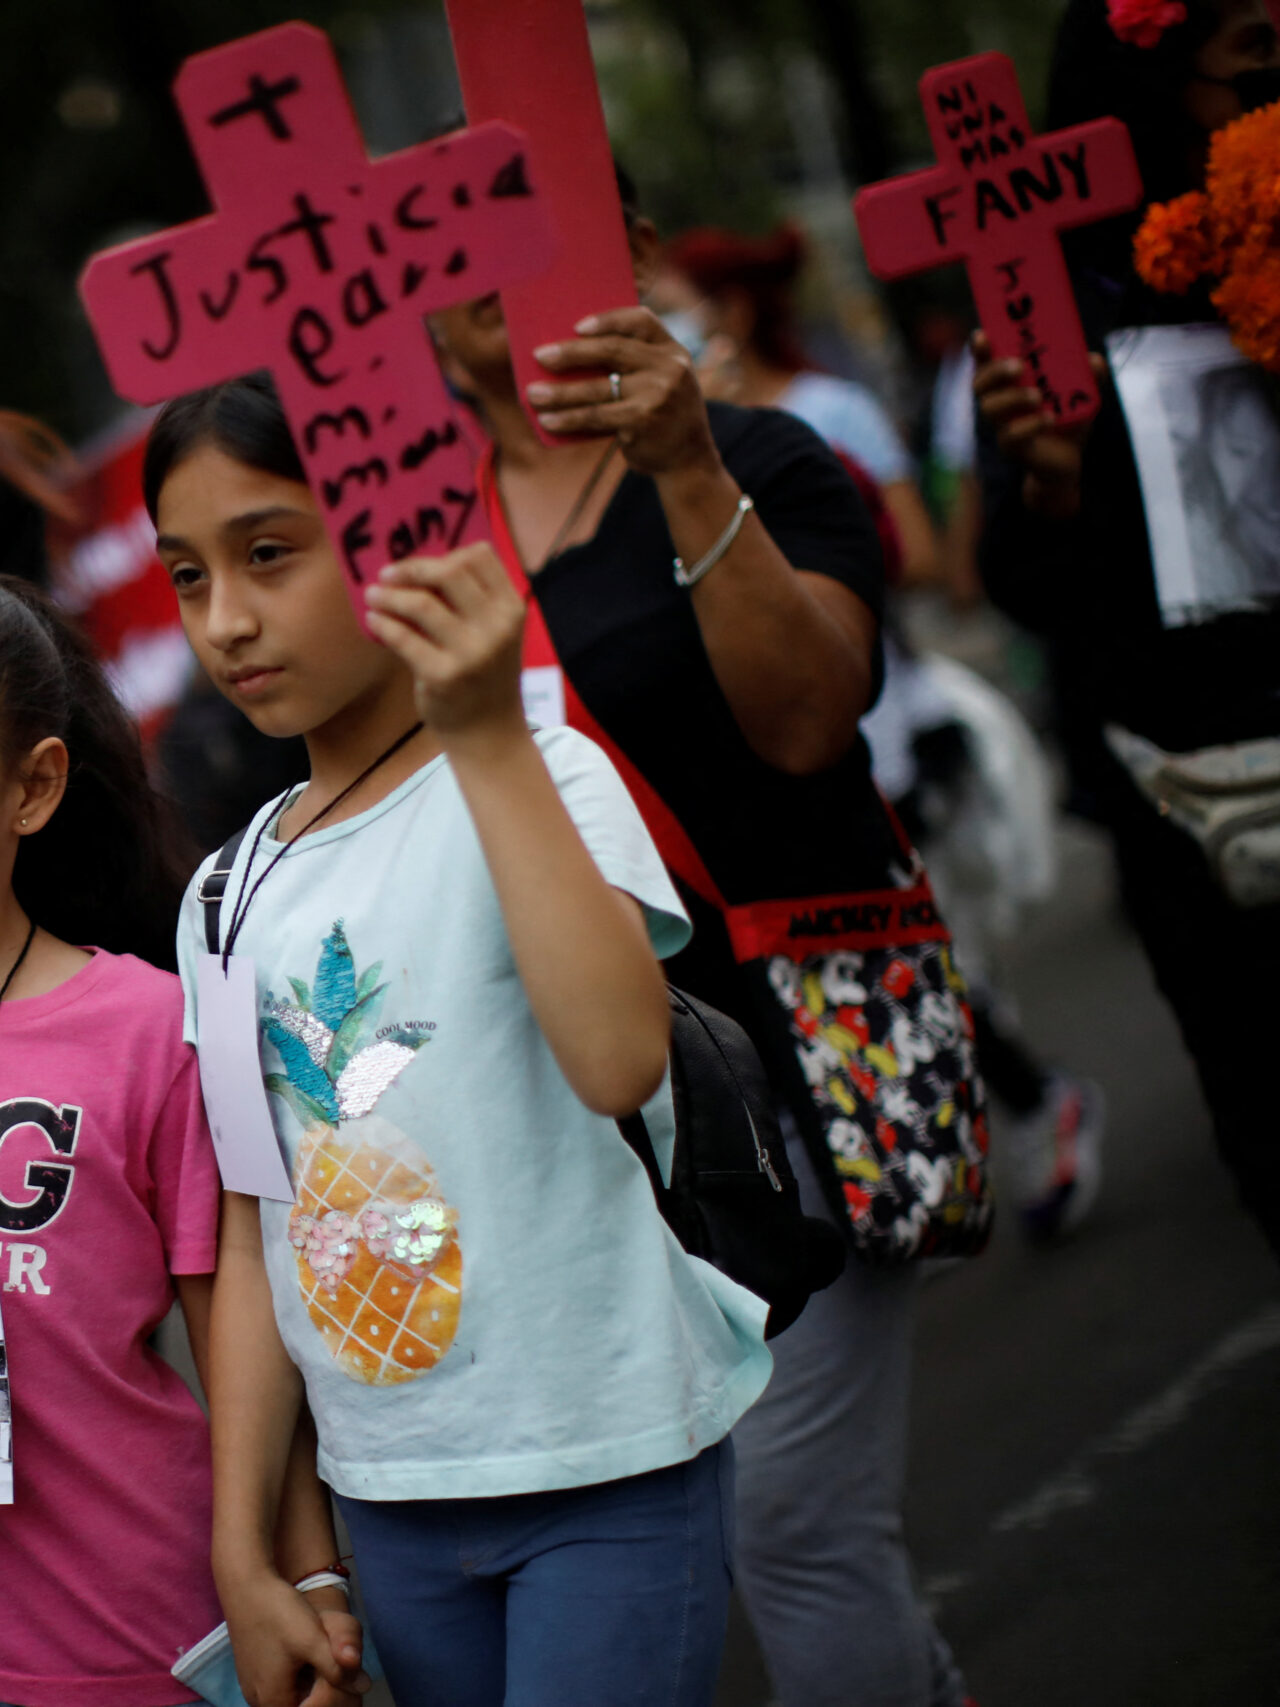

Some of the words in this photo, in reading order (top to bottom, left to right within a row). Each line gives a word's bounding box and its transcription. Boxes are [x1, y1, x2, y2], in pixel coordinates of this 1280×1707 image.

[936, 82, 978, 115] NI
[945, 101, 1006, 141] UNA
[925, 141, 1090, 246] FANY
[341, 486, 477, 585] Fany
[376, 1023, 401, 1040] COOL
[405, 1020, 437, 1031] MOOD
